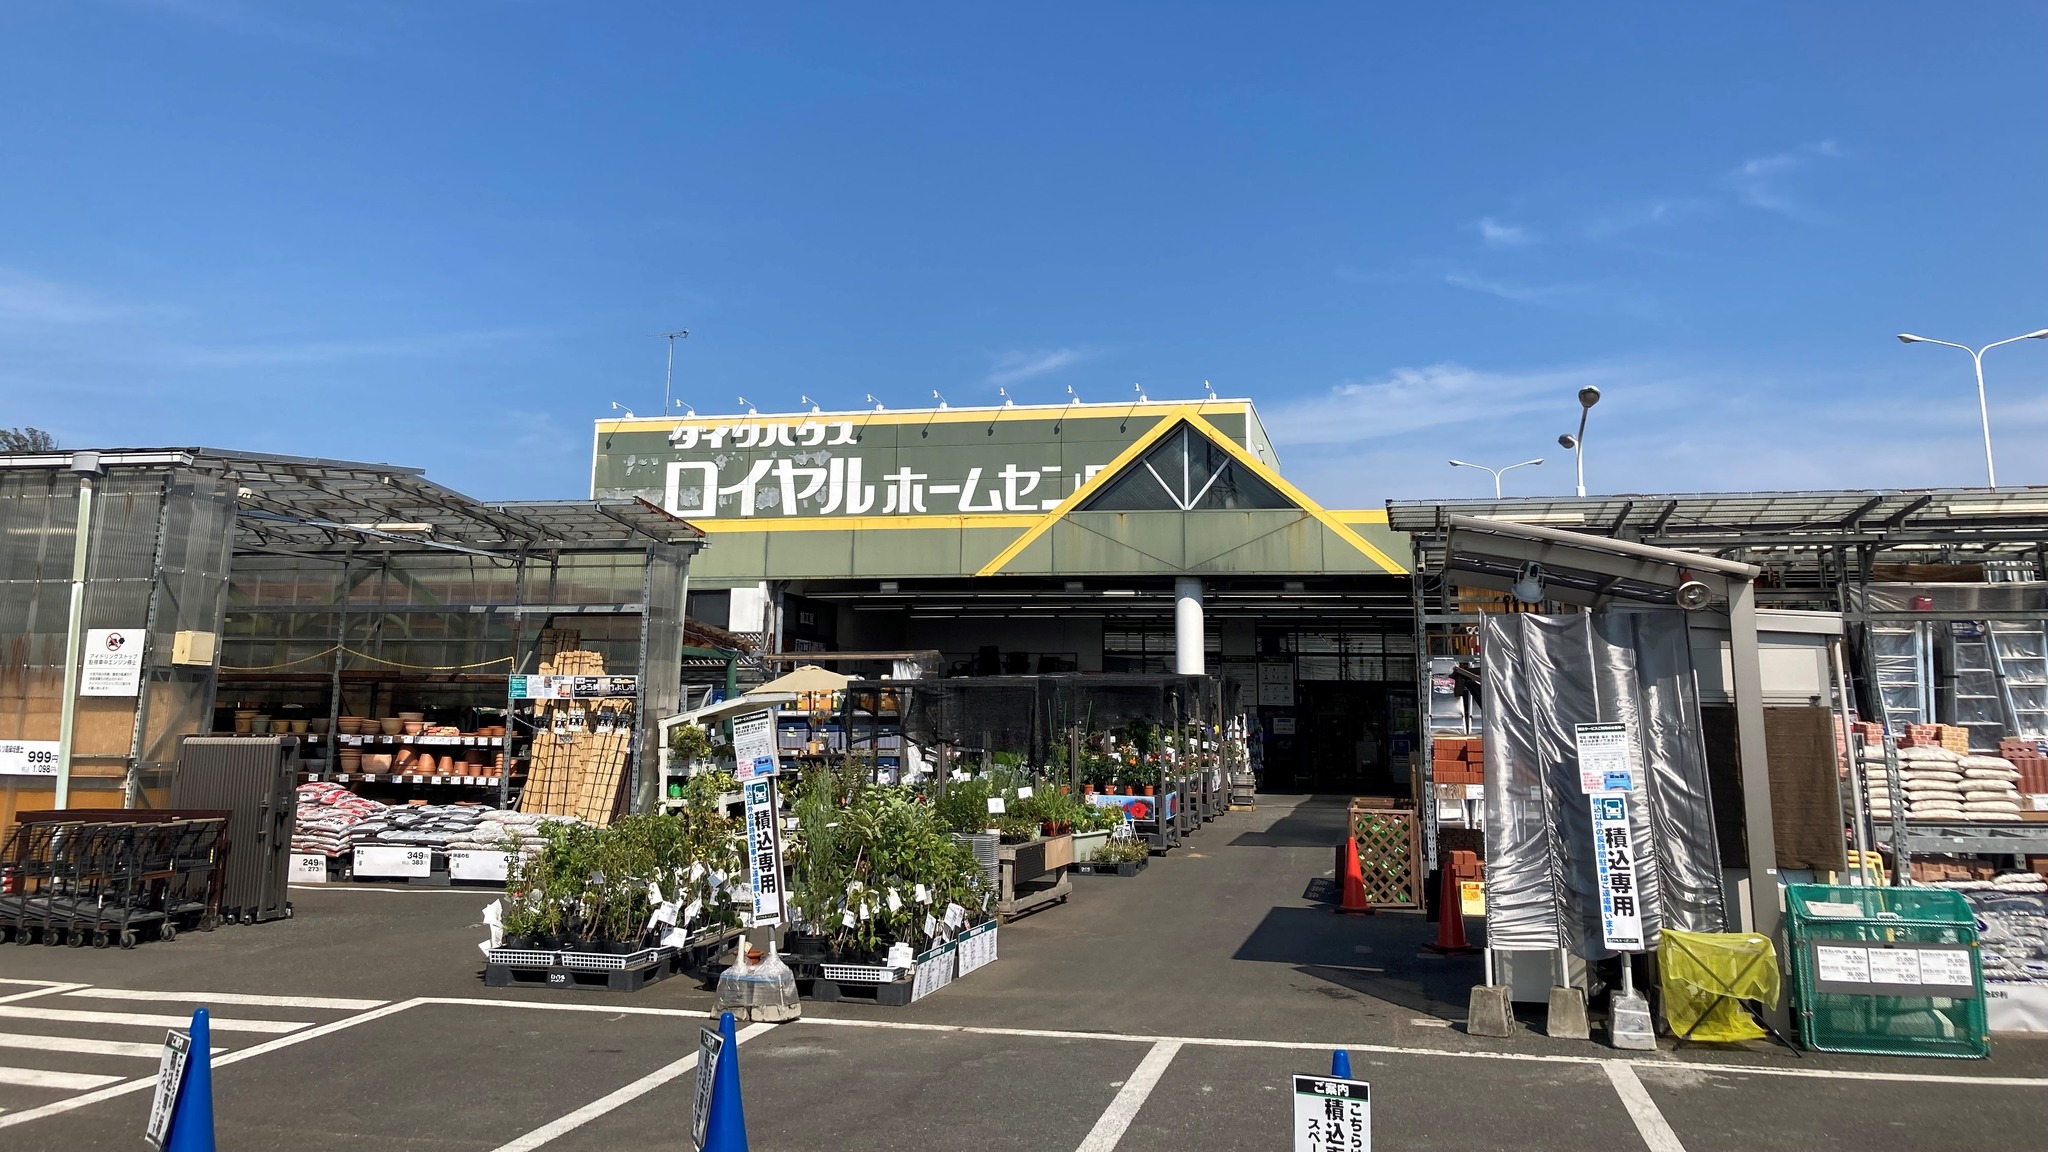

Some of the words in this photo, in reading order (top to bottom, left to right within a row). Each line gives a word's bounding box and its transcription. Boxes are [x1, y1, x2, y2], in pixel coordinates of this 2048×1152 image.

[668, 421, 857, 449] ダイワハウス
[664, 457, 875, 518] ロイヤル
[27, 750, 59, 764] 999円
[302, 858, 324, 867] 249円
[407, 851, 429, 860] 349円
[754, 809, 776, 894] 積込専用
[1592, 797, 1614, 936] 積込以外の長時間駐車はご遠慮願います
[1605, 827, 1635, 917] 積込専用
[1314, 1081, 1349, 1097] ご案内
[1349, 1102, 1363, 1152] こちら
